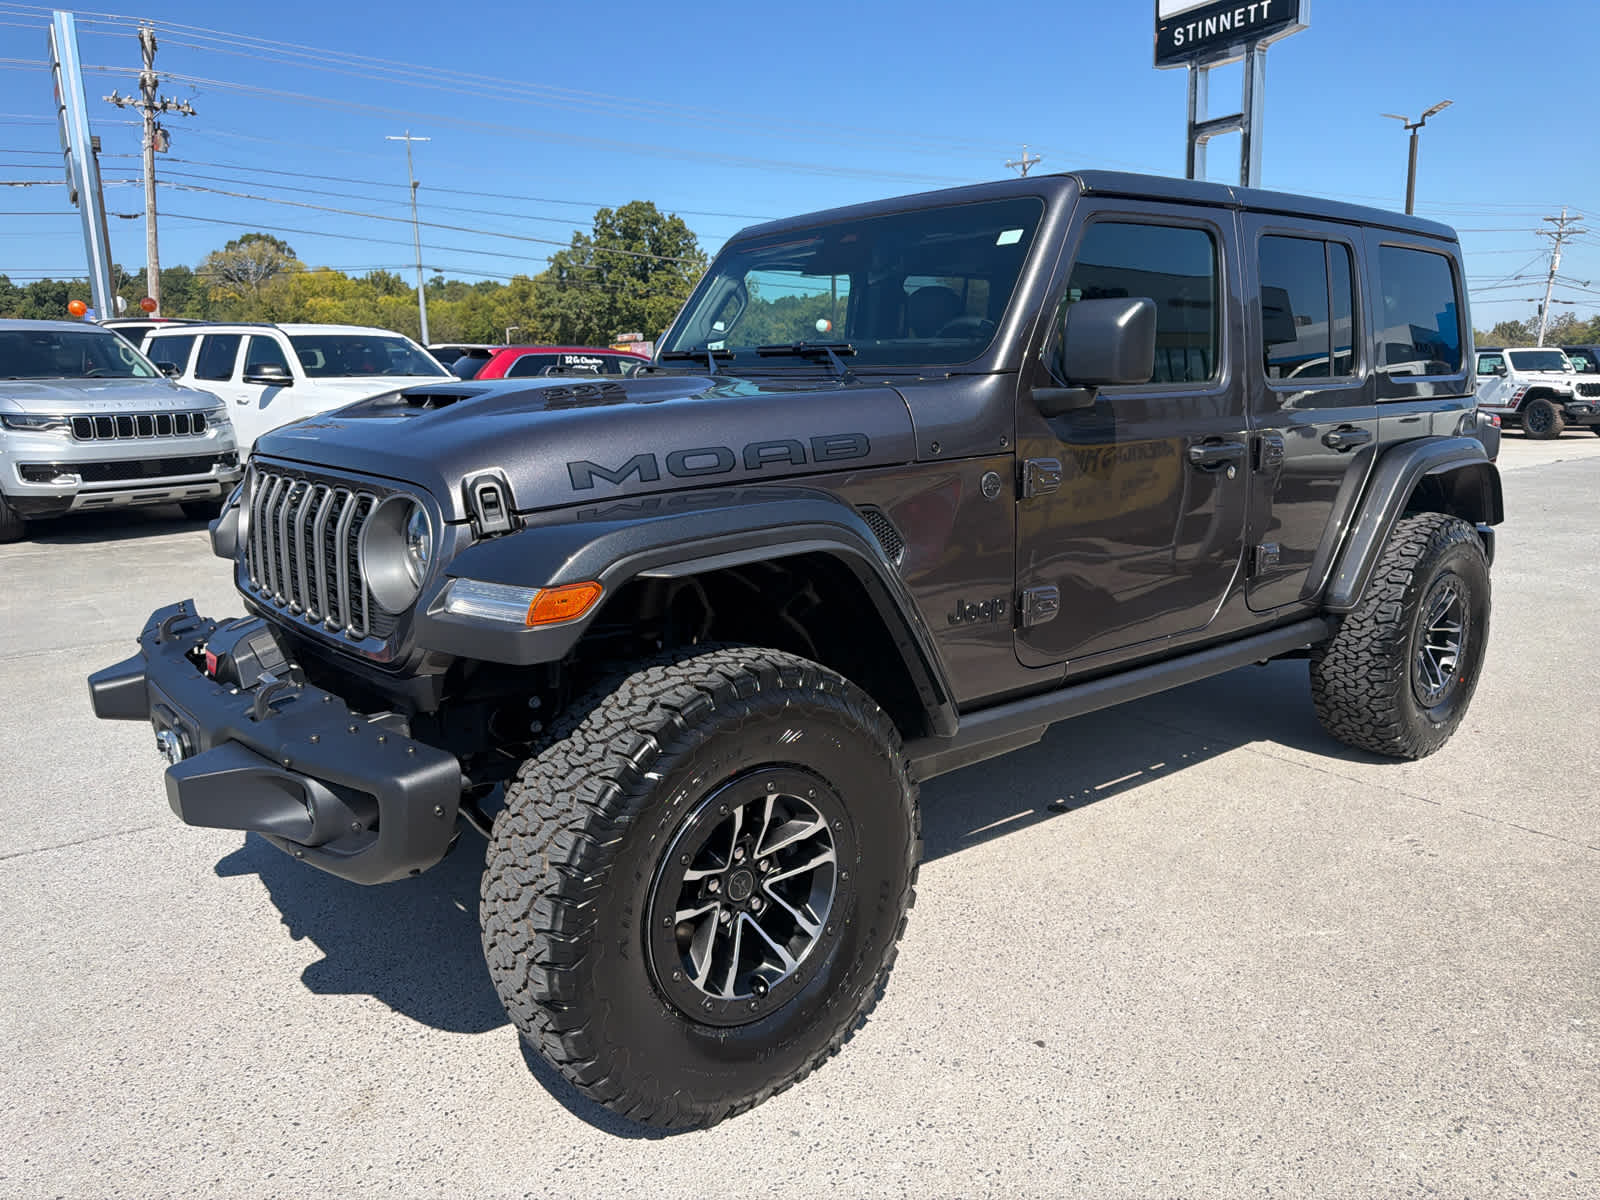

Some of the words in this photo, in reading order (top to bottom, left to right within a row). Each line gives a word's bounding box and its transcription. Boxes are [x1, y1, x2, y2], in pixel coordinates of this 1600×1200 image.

[1173, 0, 1272, 46] STINNETT
[566, 432, 871, 491] MOAB
[947, 597, 1006, 626] Jeep
